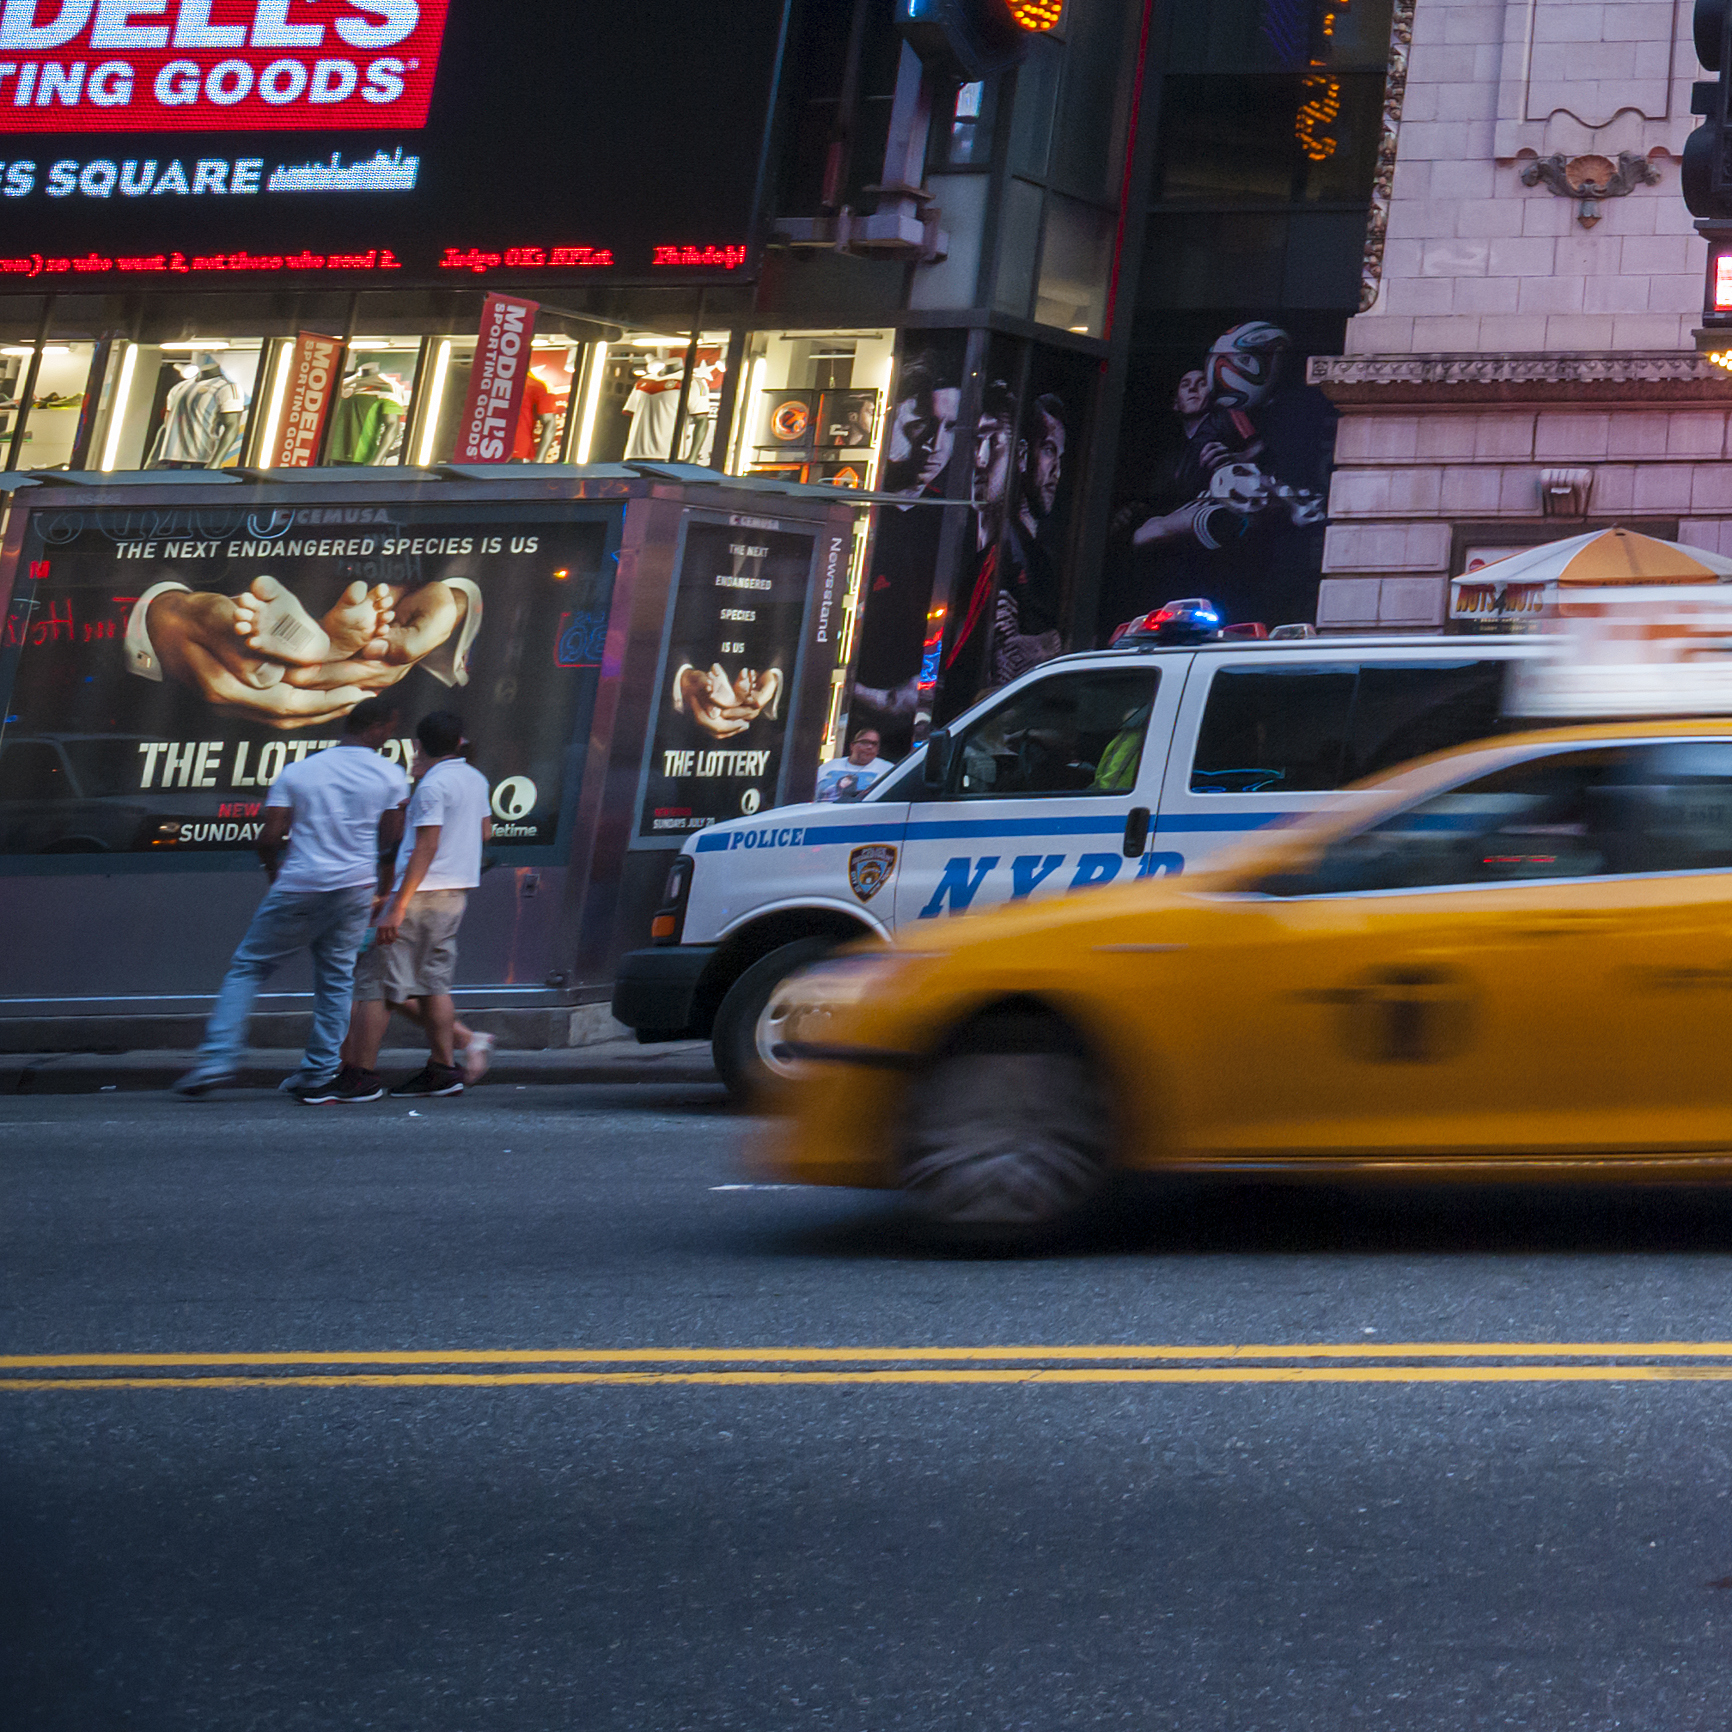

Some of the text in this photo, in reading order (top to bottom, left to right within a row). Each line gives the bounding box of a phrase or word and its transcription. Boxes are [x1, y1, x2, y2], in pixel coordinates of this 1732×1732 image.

[153, 57, 408, 107] GOODS
[0, 157, 265, 199] S SQUARE
[465, 302, 507, 459] SPORTING GOODS
[478, 304, 527, 460] MODELL'S
[297, 507, 389, 525] CEMUSA
[115, 542, 156, 560] THE
[164, 541, 221, 559] NEXT
[227, 539, 375, 558] ENDANGERED
[381, 537, 474, 556] SPECIES
[480, 537, 502, 555] IS
[509, 536, 540, 555] US
[729, 543, 770, 558] THE NEXT
[715, 575, 772, 590] ENDANGERED
[815, 536, 844, 644] Newsstand
[720, 609, 757, 622] SPECIES
[721, 641, 731, 653] IS
[138, 738, 421, 789] THE LOTY
[663, 750, 771, 777] THE LOTTERY
[218, 802, 262, 818] NEW
[178, 822, 265, 843] SUNDAY
[730, 827, 805, 850] POLICE
